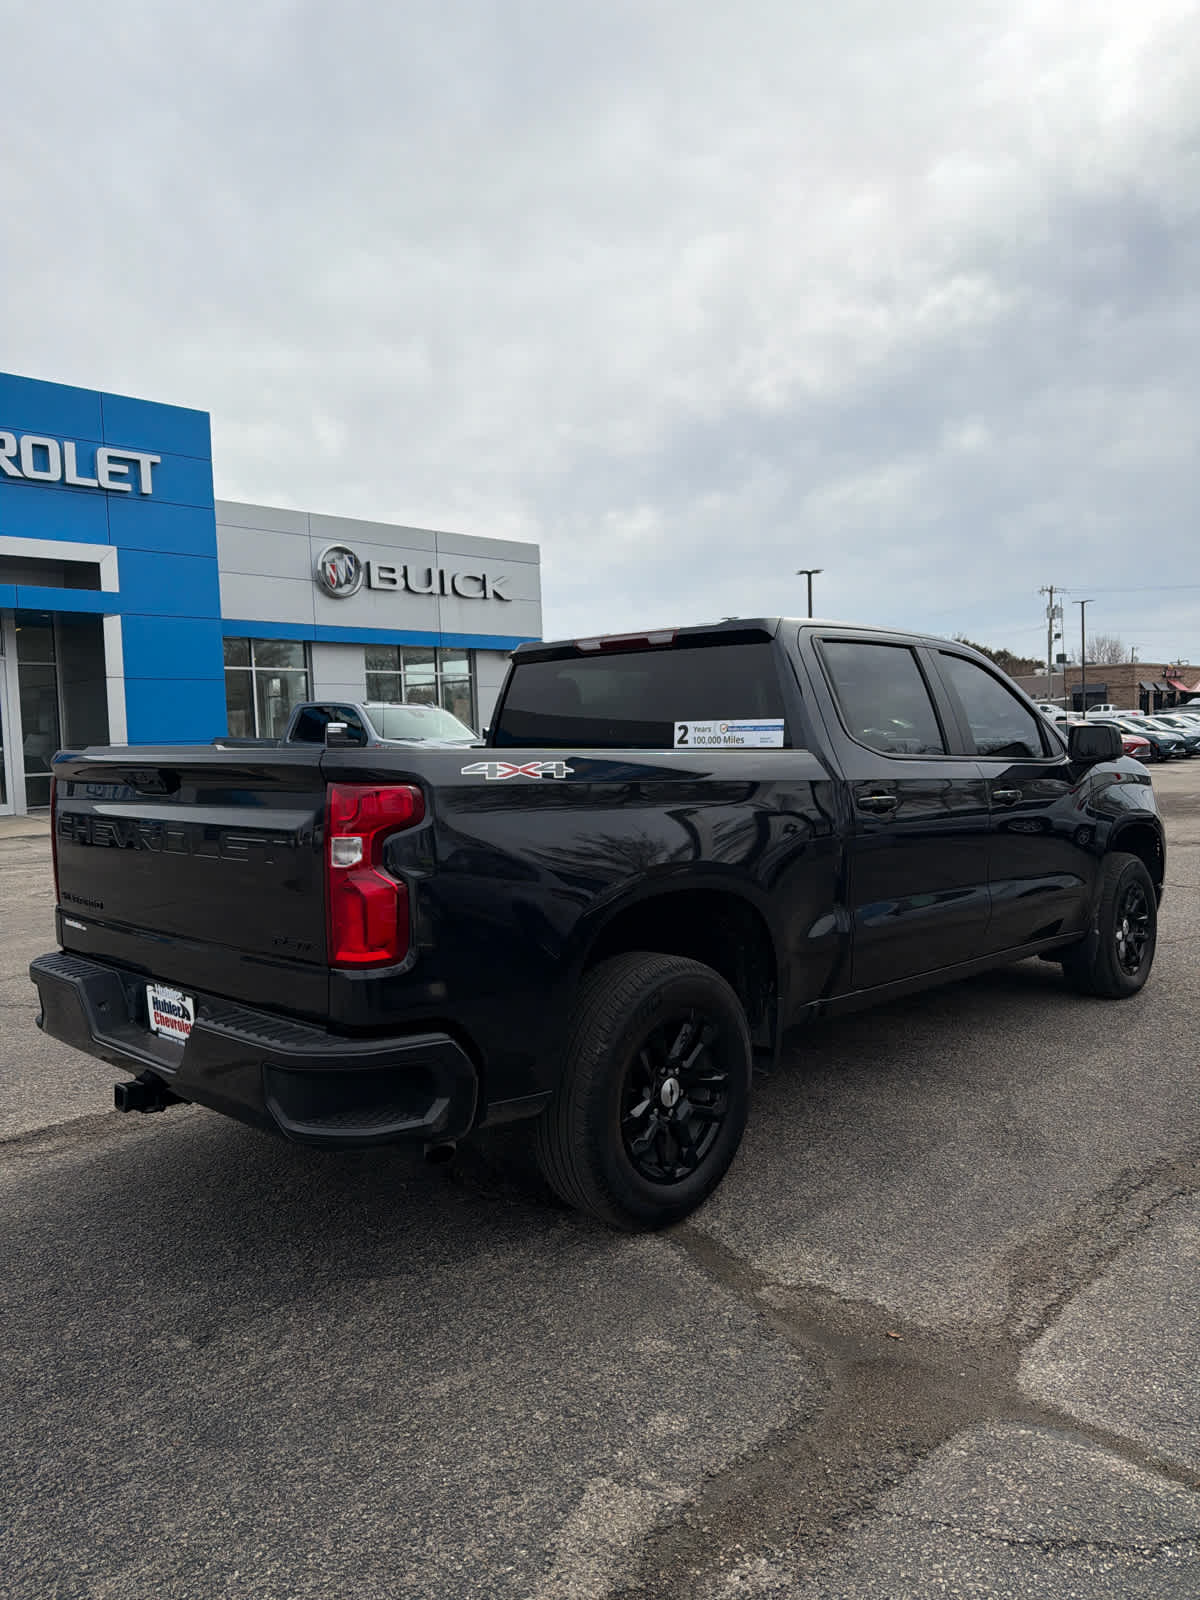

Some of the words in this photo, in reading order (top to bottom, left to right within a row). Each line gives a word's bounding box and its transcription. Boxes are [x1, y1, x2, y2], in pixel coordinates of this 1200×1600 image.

[366, 560, 512, 602] BUICK
[677, 725, 689, 744] 2
[693, 735, 721, 746] 100,000
[723, 735, 744, 744] Miles
[152, 996, 181, 1017] Hubler
